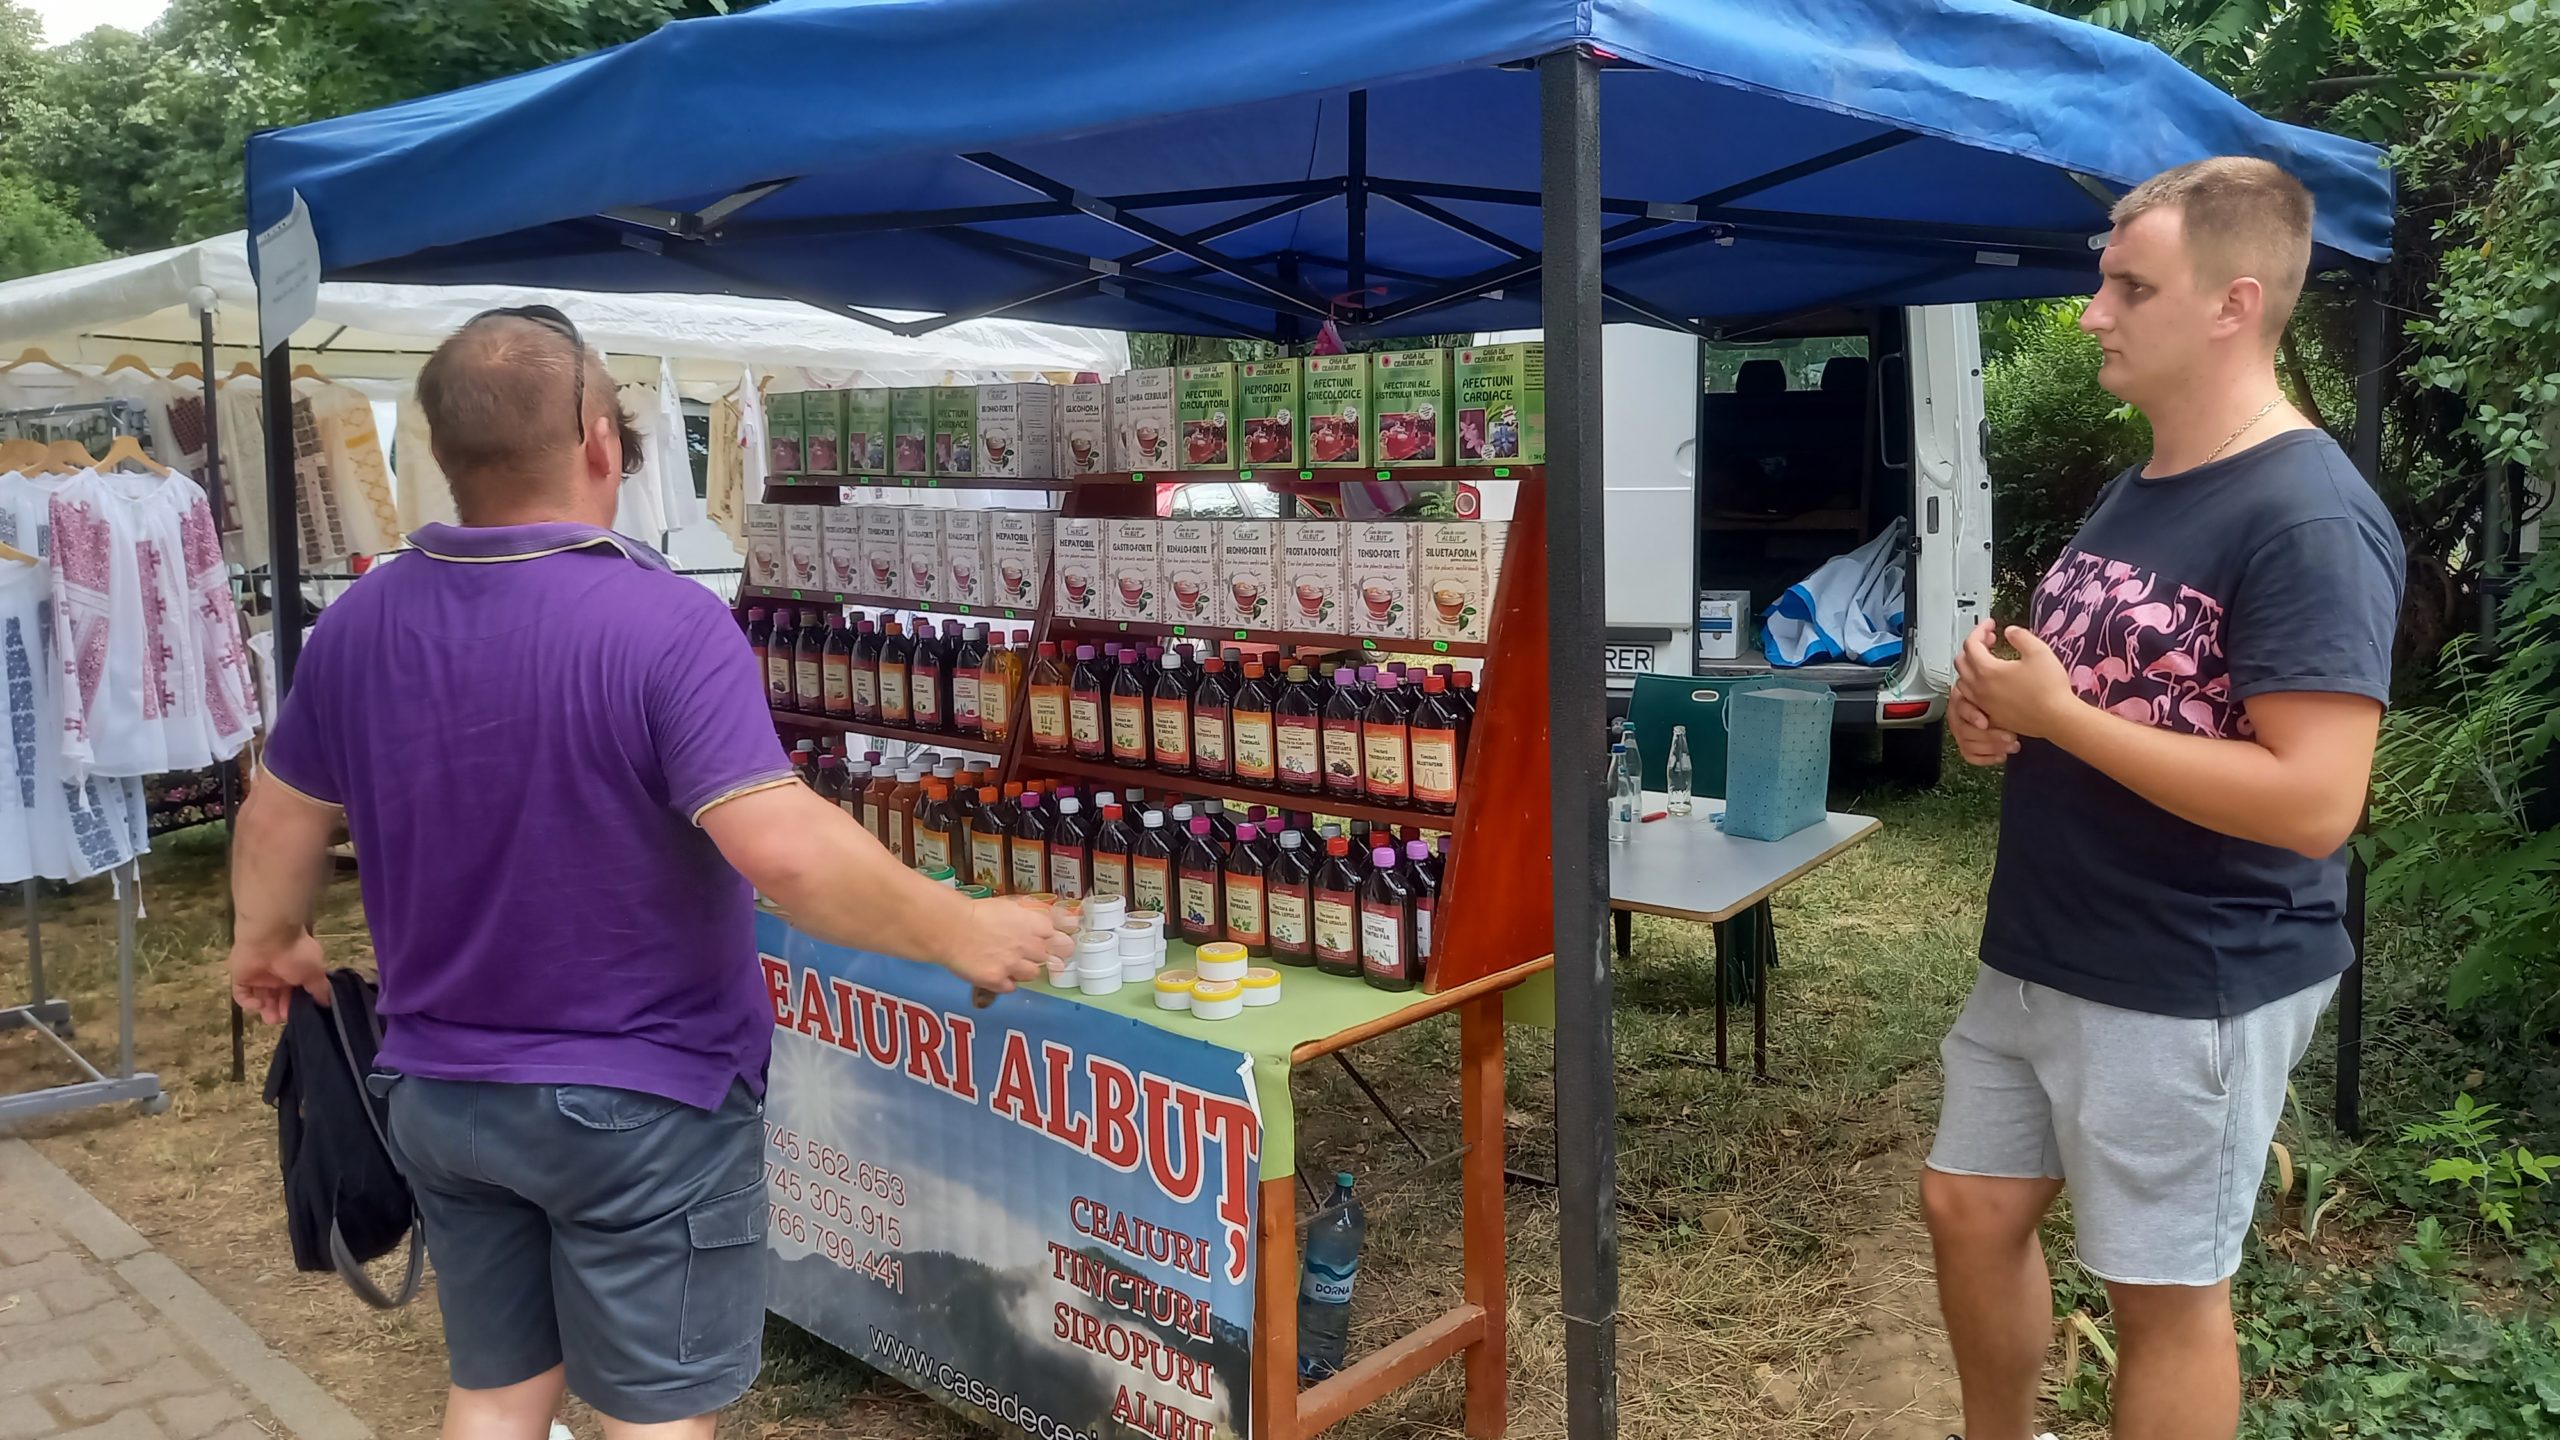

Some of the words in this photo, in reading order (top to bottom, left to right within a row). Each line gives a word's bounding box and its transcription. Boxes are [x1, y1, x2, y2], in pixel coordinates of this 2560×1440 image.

[1313, 378, 1353, 388] AFECTIUNI
[1418, 380, 1431, 388] ALE
[1462, 375, 1513, 388] AFECTIUNI
[1244, 382, 1291, 395] HEMOROIZI
[1375, 391, 1412, 399] SISTEMULUI
[1413, 389, 1440, 398] NERVOS
[1115, 396, 1126, 404] GLIC
[1185, 389, 1223, 400] AFECTIUNI
[1307, 389, 1362, 400] GINECOLOGICE
[1463, 390, 1513, 402] CARDIACE
[1065, 404, 1099, 413] GLICONORM
[995, 532, 1029, 542] HEPATOBIL
[1060, 539, 1095, 548] HEPATOBIL
[1112, 543, 1153, 552] GASTRO-FORTE
[1166, 545, 1207, 554] RENALO-FORTE
[1226, 546, 1267, 555] BRONHO-FORTE
[1285, 547, 1337, 557] PROSTATO-FORTE
[1425, 548, 1478, 557] SILUETAFORM
[759, 954, 977, 1103] EAIURI
[990, 1031, 1259, 1283] ALBUȚ
[763, 1122, 800, 1160] 745
[807, 1140, 906, 1207] 562.653
[765, 1161, 803, 1202] 745
[809, 1181, 902, 1248] 305.915
[1070, 1195, 1211, 1280] CEAIURI
[769, 1202, 806, 1244] 766
[811, 1221, 904, 1294] 799.441
[1048, 1240, 1212, 1341] TINCTURI
[1315, 1283, 1350, 1296] DORNA
[1053, 1301, 1213, 1401] SIROPURI
[868, 1325, 1097, 1440] www.casadece
